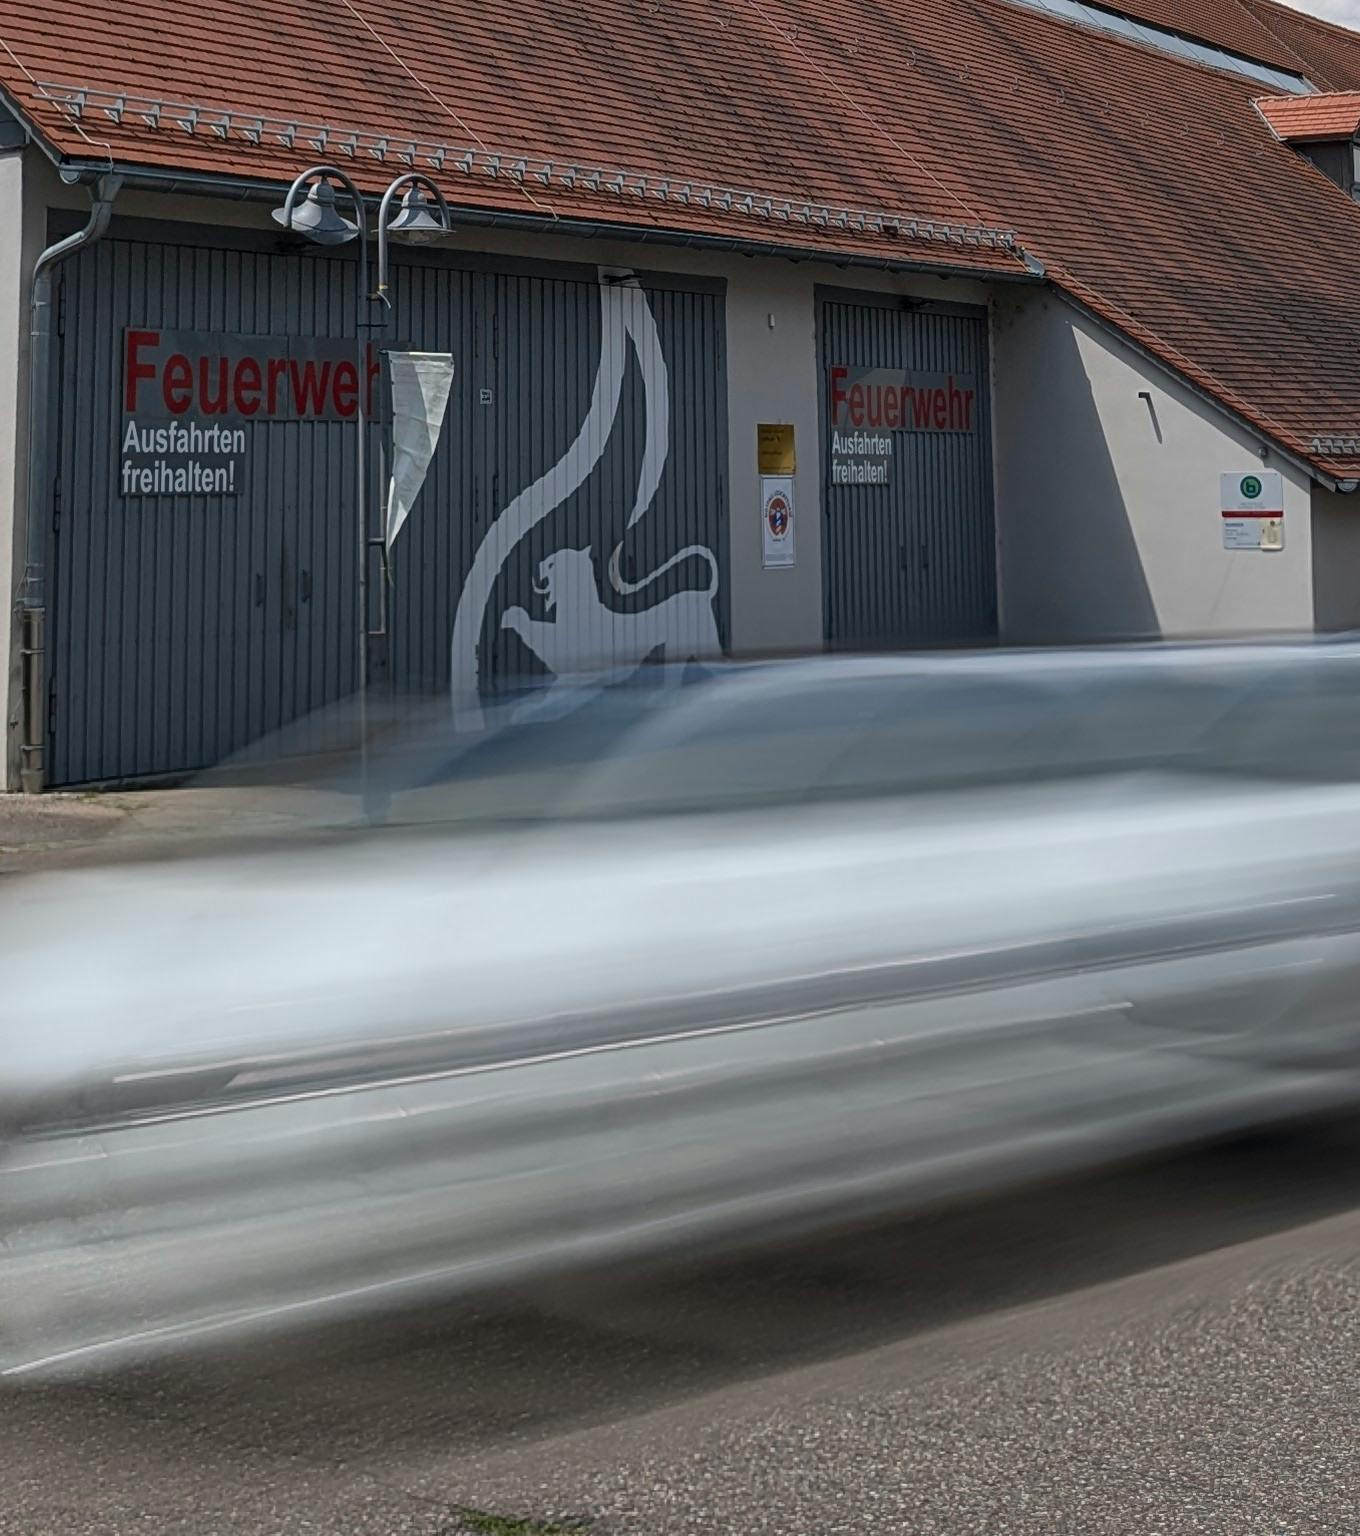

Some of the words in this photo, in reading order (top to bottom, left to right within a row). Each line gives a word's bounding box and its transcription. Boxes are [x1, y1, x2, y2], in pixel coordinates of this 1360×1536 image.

[125, 330, 381, 416] Feuerweh
[830, 366, 975, 431] Feuerwehr
[122, 420, 246, 454] Ausfahrten
[831, 430, 892, 456] Ausfahrten
[121, 459, 235, 494] freihalten!
[832, 459, 888, 484] freihalten!
